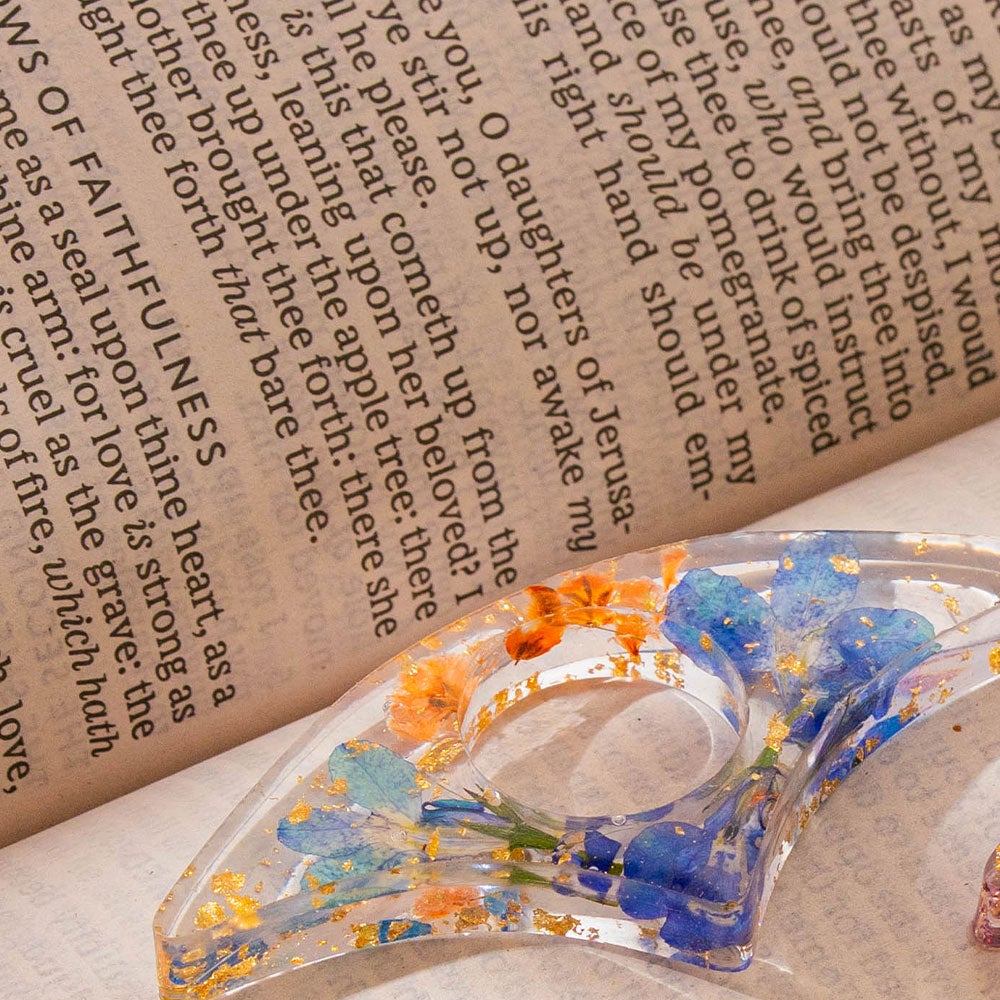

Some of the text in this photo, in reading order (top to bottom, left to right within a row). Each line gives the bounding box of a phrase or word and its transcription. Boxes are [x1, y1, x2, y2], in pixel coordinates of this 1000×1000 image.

[337, 21, 376, 72] he
[357, 77, 436, 208] please.
[425, 20, 483, 104] you,
[636, 50, 678, 87] of
[656, 92, 701, 150] my
[940, 5, 973, 46] as
[16, 155, 53, 196] as
[39, 201, 64, 226] a
[479, 112, 510, 140] O
[801, 4, 955, 395] ould not be despised.
[845, 0, 998, 390] thee without, I would
[933, 90, 973, 128] of
[953, 144, 992, 203] my
[0, 5, 226, 466] WS OF FAITHFULNESS
[51, 229, 109, 305] seal
[122, 71, 329, 543] thee forth that bare thee.
[128, 0, 398, 638] other brought thee forth: there she
[182, 1, 437, 621] thee up under the apple tree: there
[281, 9, 313, 37] is
[302, 45, 352, 117] this
[341, 124, 397, 204] that
[381, 213, 458, 359] cometh
[443, 366, 476, 418] up
[462, 427, 504, 523] from
[488, 528, 519, 588] the
[366, 0, 410, 45] ye
[401, 56, 450, 117] stir
[437, 128, 489, 198] not
[475, 206, 510, 273] up,
[504, 282, 548, 350] nor
[533, 365, 584, 486] awake
[566, 496, 598, 552] my
[496, 153, 589, 346] daughters
[542, 52, 714, 501] right hand should em-
[565, 3, 622, 75] and
[607, 93, 688, 219] should
[671, 234, 704, 280] be
[693, 298, 743, 413] under
[725, 430, 756, 484] my
[679, 160, 785, 424] pomegranate.
[685, 51, 841, 456] thee to drink of spiced
[743, 79, 877, 440] who would instruct
[787, 76, 913, 422] and bring thee into
[90, 307, 148, 413] upon
[272, 82, 356, 227] leaning
[344, 233, 401, 338] upon
[388, 340, 429, 409] her
[414, 414, 480, 576] beloved?
[455, 584, 484, 606] I
[576, 357, 614, 396] of
[1, 327, 156, 740] cruel as the grave: the
[23, 270, 196, 723] arm: for love is strong as
[135, 414, 187, 520] thine
[589, 405, 635, 534] Jerusa-
[0, 429, 119, 757] of fire, which hath
[171, 520, 224, 637] heart,
[203, 641, 231, 680] as
[0, 699, 30, 794] love,
[212, 684, 235, 707] a
